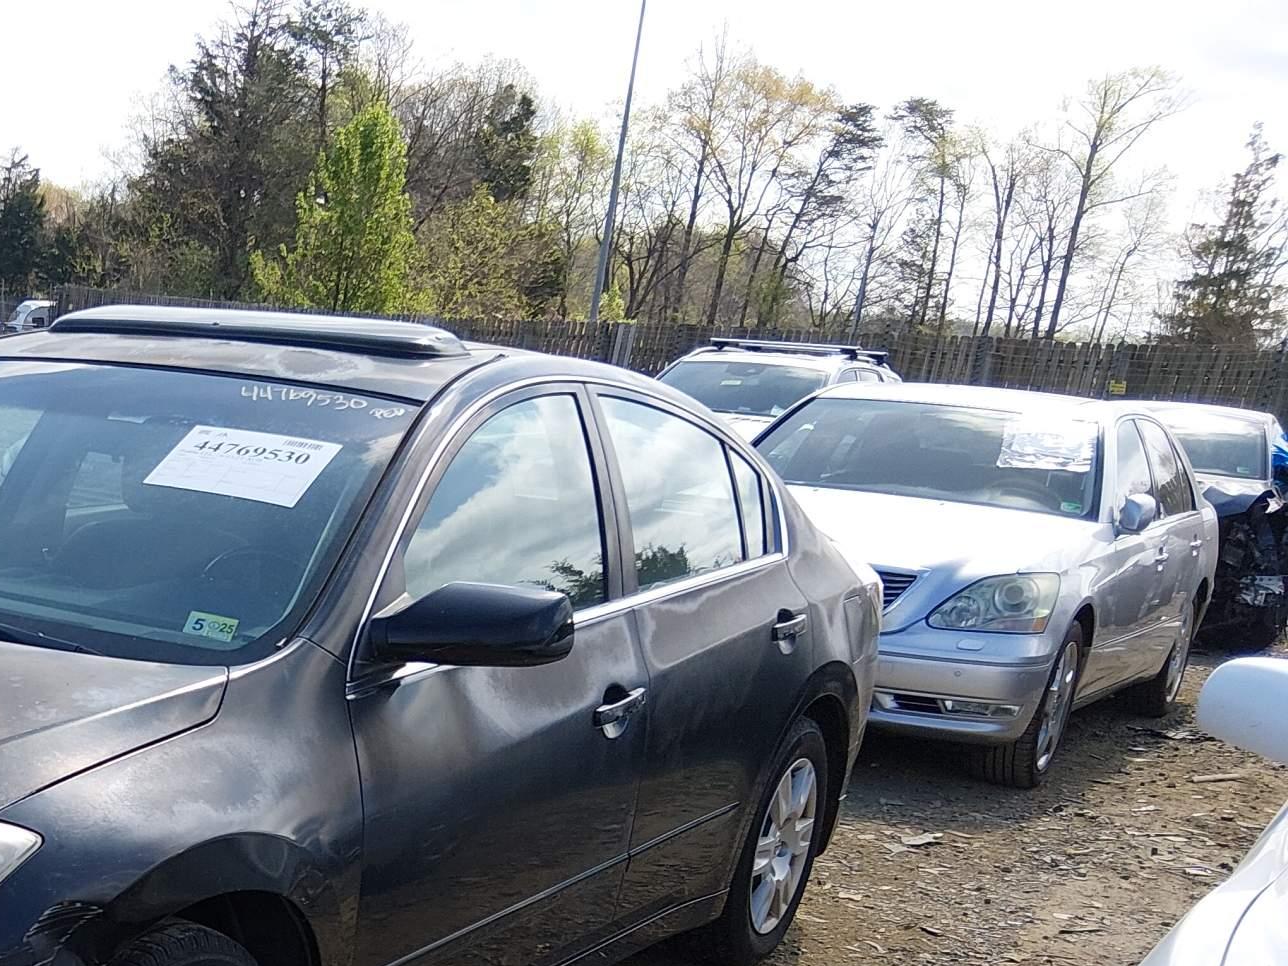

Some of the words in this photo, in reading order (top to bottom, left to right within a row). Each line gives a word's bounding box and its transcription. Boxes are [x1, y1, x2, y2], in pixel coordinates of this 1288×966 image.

[241, 386, 368, 410] 44769530
[193, 440, 310, 465] 44769530
[192, 618, 205, 631] 5
[219, 622, 234, 634] 25
